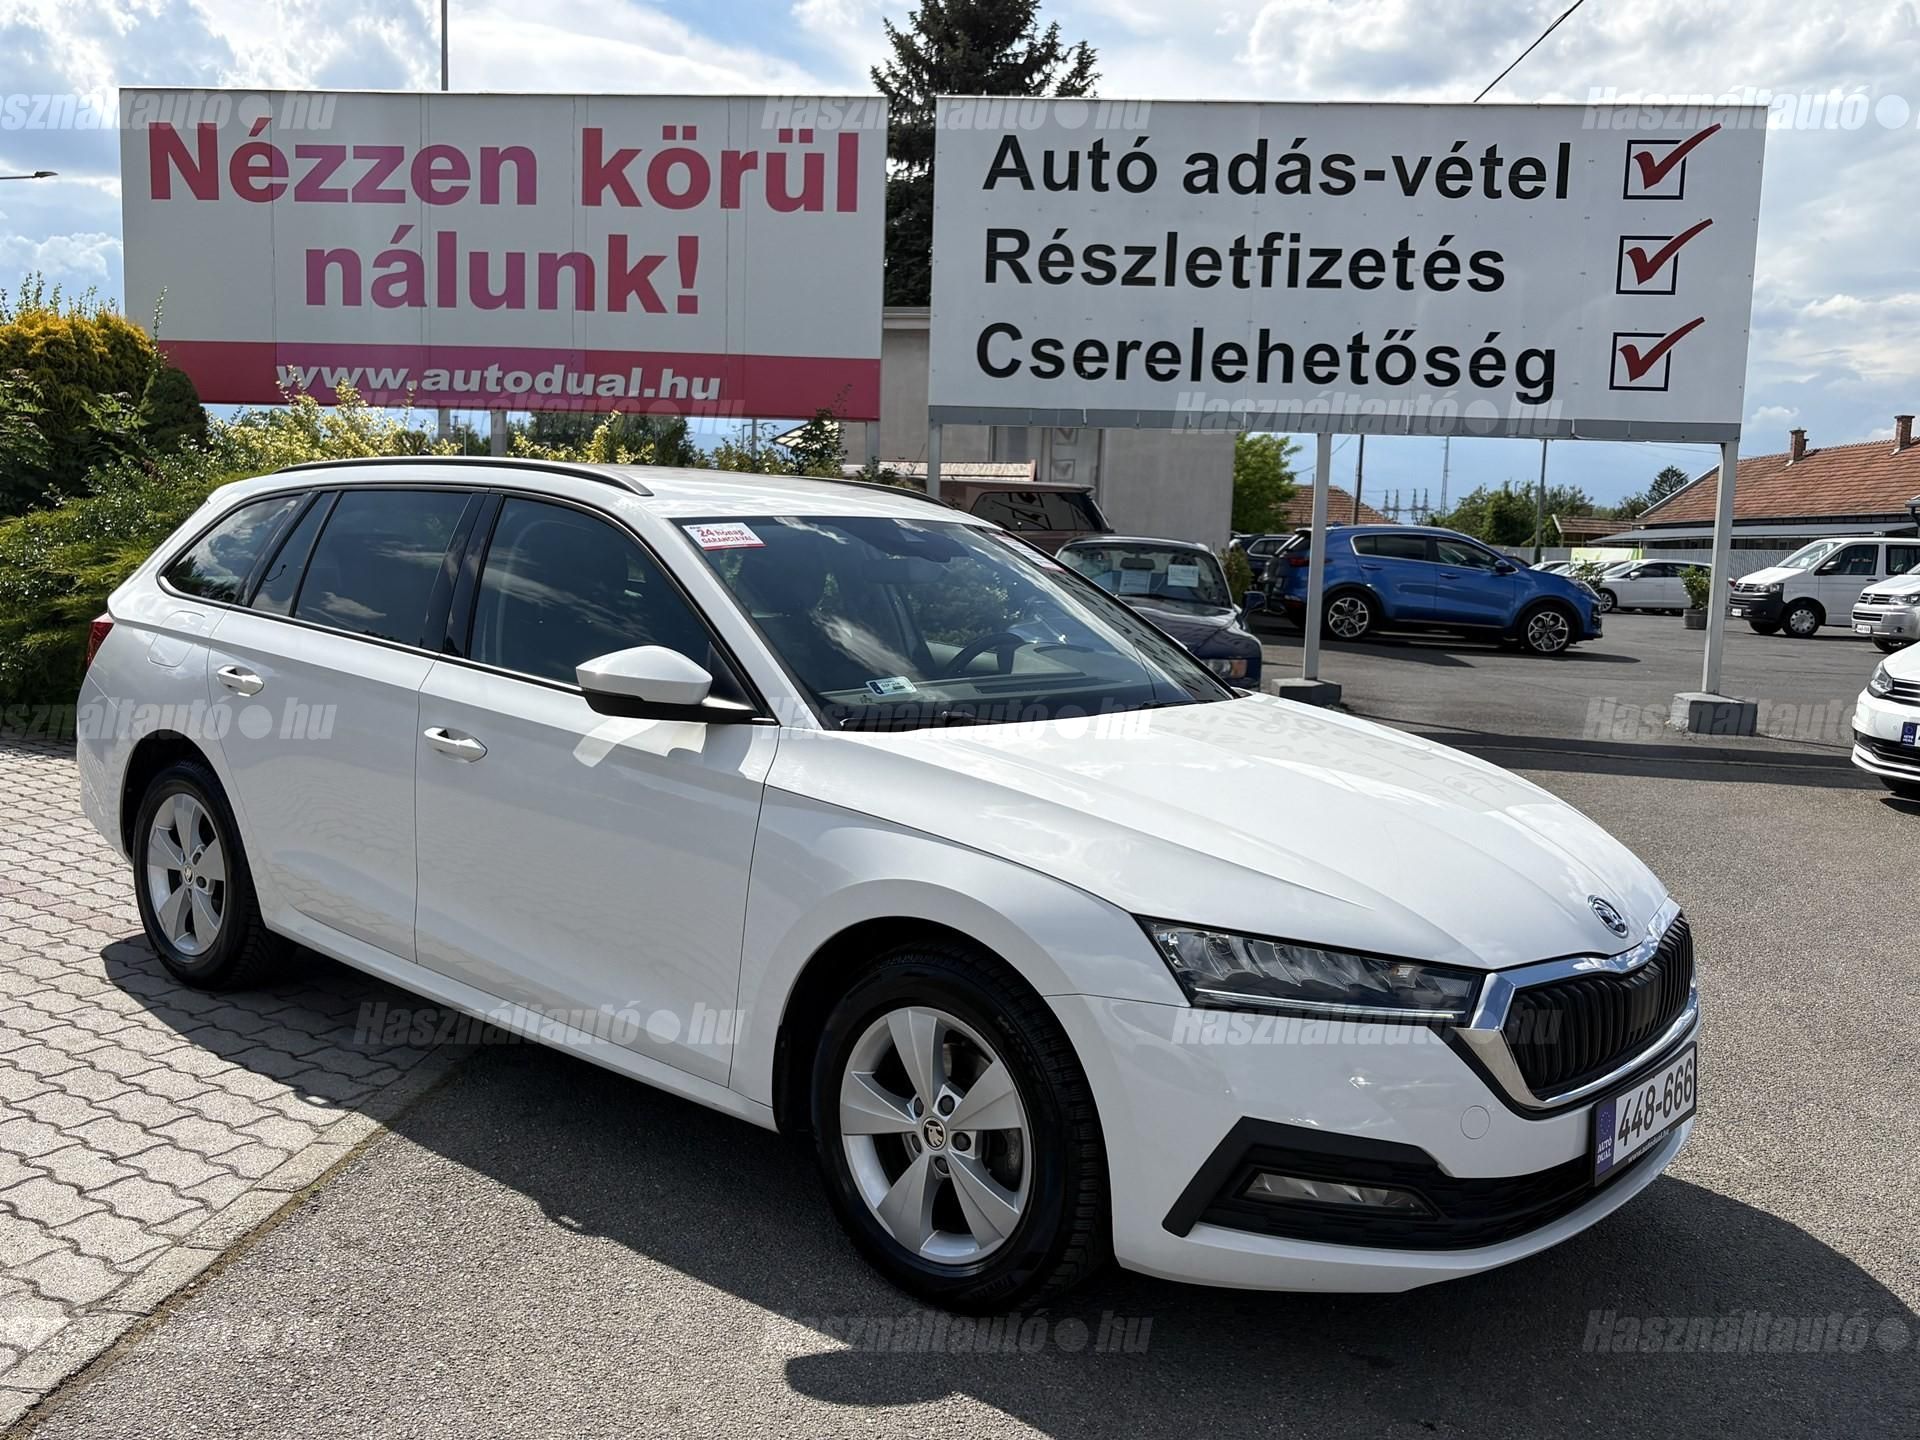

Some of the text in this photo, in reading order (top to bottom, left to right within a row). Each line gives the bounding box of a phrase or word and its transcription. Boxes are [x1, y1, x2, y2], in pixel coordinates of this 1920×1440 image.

[149, 117, 859, 213] Nézzen körül
[983, 135, 1571, 200] Autó adás-vétel
[305, 224, 700, 315] nálunk!
[984, 228, 1506, 292] Részletfizetés
[276, 364, 721, 400] www.autodual.hu
[976, 322, 1557, 405] Cserelehetőség
[1618, 1057, 1692, 1146] 448-666
